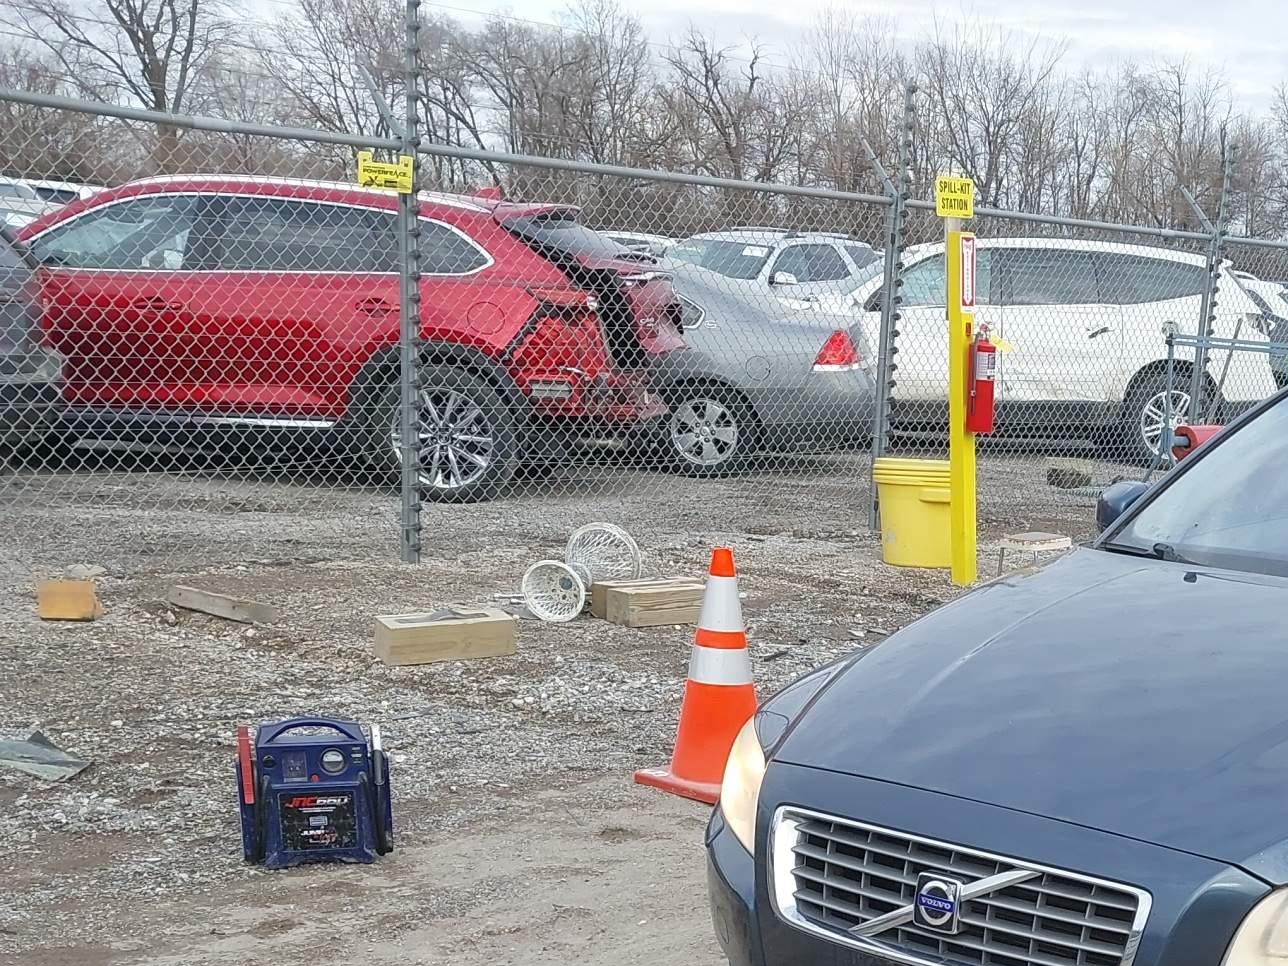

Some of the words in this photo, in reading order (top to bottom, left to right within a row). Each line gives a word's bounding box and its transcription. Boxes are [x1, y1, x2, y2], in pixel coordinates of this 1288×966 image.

[939, 180, 971, 195] SPILL-KIT
[941, 197, 968, 211] STATION
[920, 896, 952, 910] VOLVO
